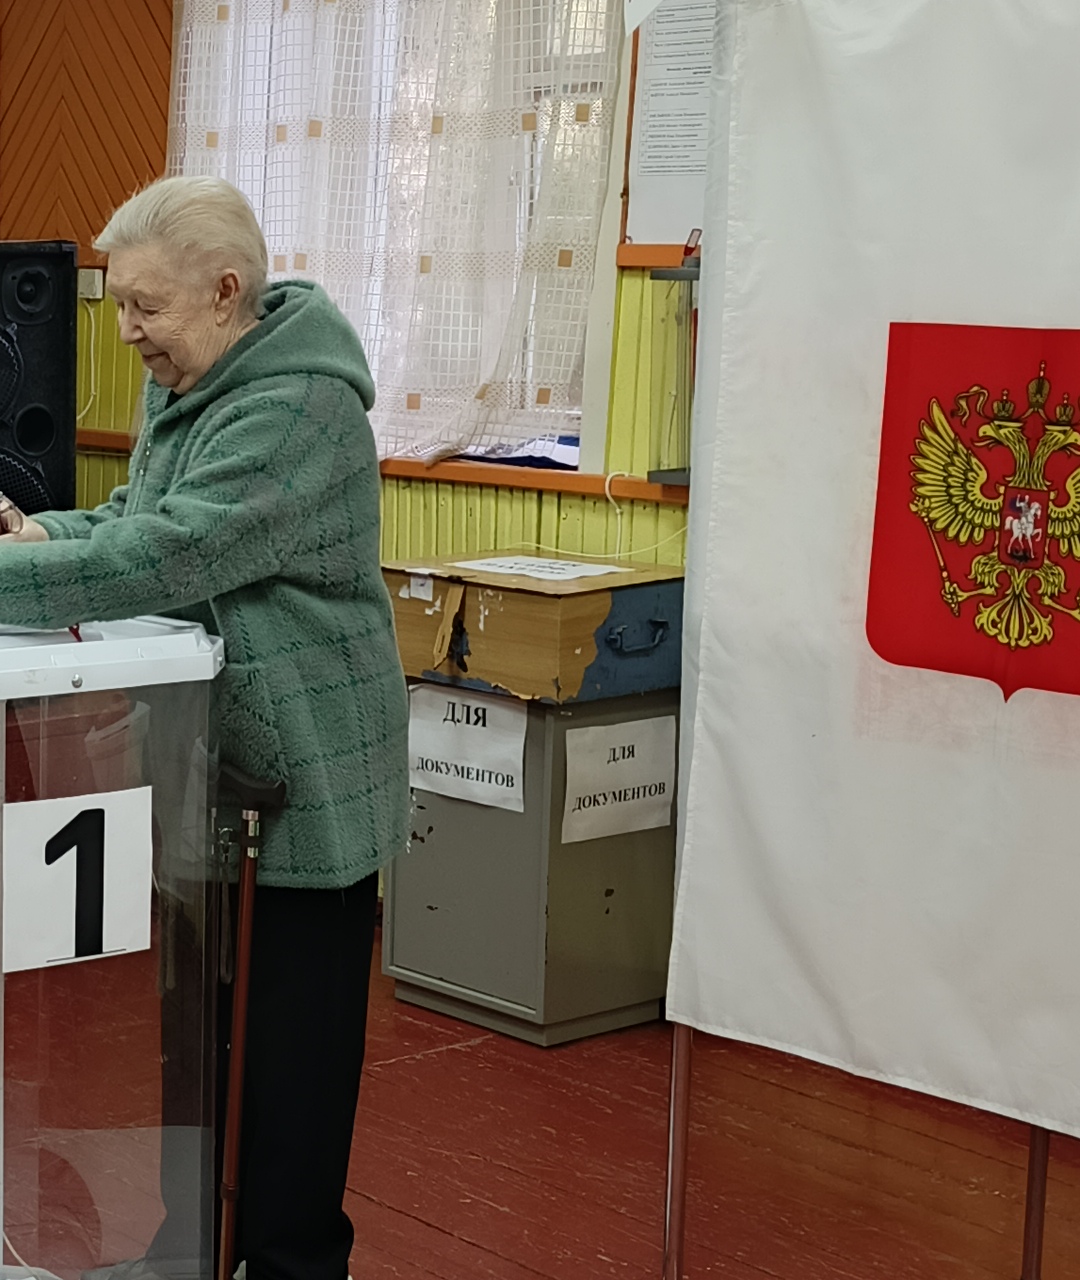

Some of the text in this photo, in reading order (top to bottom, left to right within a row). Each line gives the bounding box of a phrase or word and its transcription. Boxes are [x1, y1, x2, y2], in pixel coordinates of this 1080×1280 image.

[443, 701, 487, 727] ДЛЯ
[607, 744, 635, 765] ДЛЯ
[416, 757, 515, 788] ДОКУМЕНТОВ
[572, 782, 666, 812] ДОКУМЕНТОВ
[45, 807, 105, 958] 1
